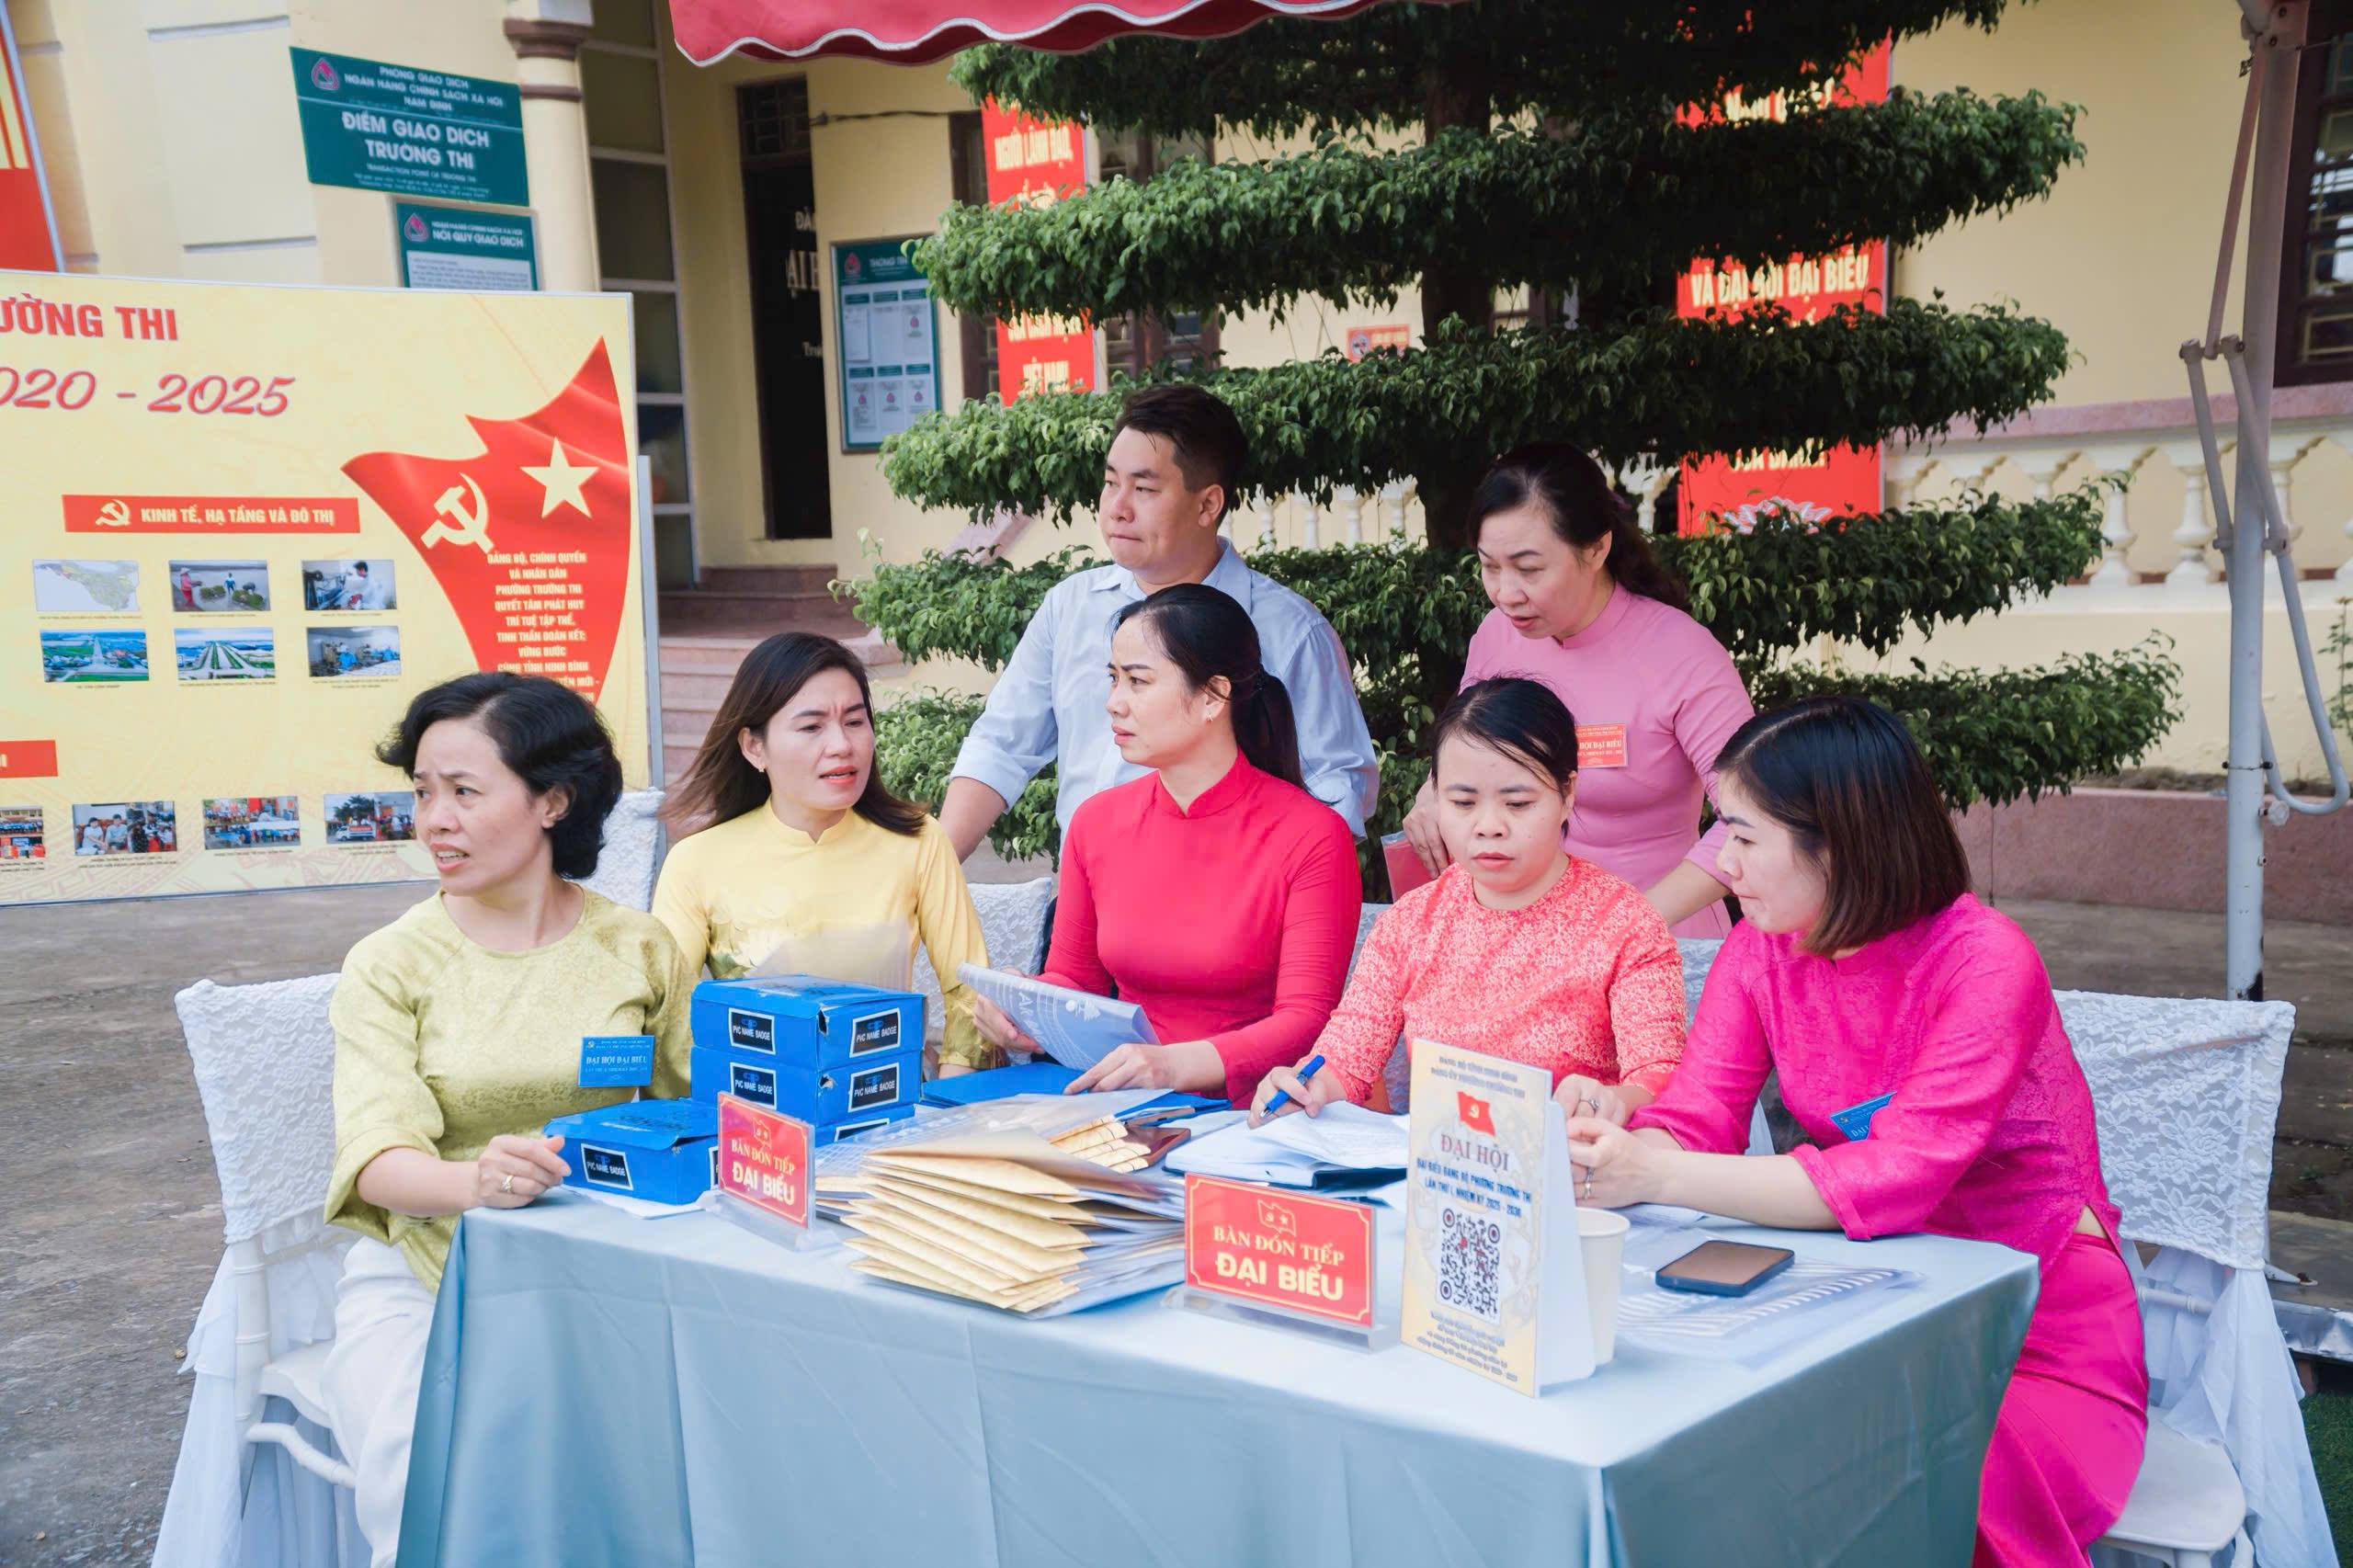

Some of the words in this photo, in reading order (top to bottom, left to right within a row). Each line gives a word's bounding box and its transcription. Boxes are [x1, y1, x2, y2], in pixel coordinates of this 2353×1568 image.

[392, 119, 441, 142] GIAO
[447, 149, 474, 170] THI
[473, 233, 499, 244] GIAO
[115, 306, 178, 340] THI
[147, 373, 296, 417] 2025
[141, 507, 176, 523] KINH
[205, 508, 225, 526] HẠ
[267, 506, 288, 523] VÀ
[733, 1025, 742, 1035] PVC
[742, 1026, 755, 1038] NAME
[756, 1029, 771, 1041] BADGE
[857, 1033, 866, 1043] PVC
[866, 1029, 880, 1040] NAME
[881, 1025, 897, 1038] BADGE
[734, 1079, 744, 1089] PVC
[744, 1081, 756, 1091] NAME
[757, 1084, 773, 1095] BADGE
[854, 1087, 863, 1097] PVC
[864, 1084, 878, 1095] NAME
[879, 1080, 895, 1092] BADGE
[732, 1138, 751, 1157] BÀN
[752, 1146, 771, 1166] ĐÓN
[773, 1155, 795, 1176] TIẾP
[1440, 1133, 1471, 1161] ĐẠI
[1476, 1143, 1509, 1174] HỘI
[586, 1161, 596, 1171] PVC
[596, 1163, 609, 1174] NAME
[609, 1166, 626, 1177] BADGE
[733, 1161, 758, 1192] ĐẠI
[763, 1173, 795, 1206] BIỂU
[1213, 1225, 1251, 1248] BÀN
[1255, 1233, 1295, 1257] ĐÓN
[1301, 1243, 1345, 1267] TIẾP
[1215, 1252, 1267, 1288] ĐẠI
[1279, 1264, 1344, 1301] BIỂU
